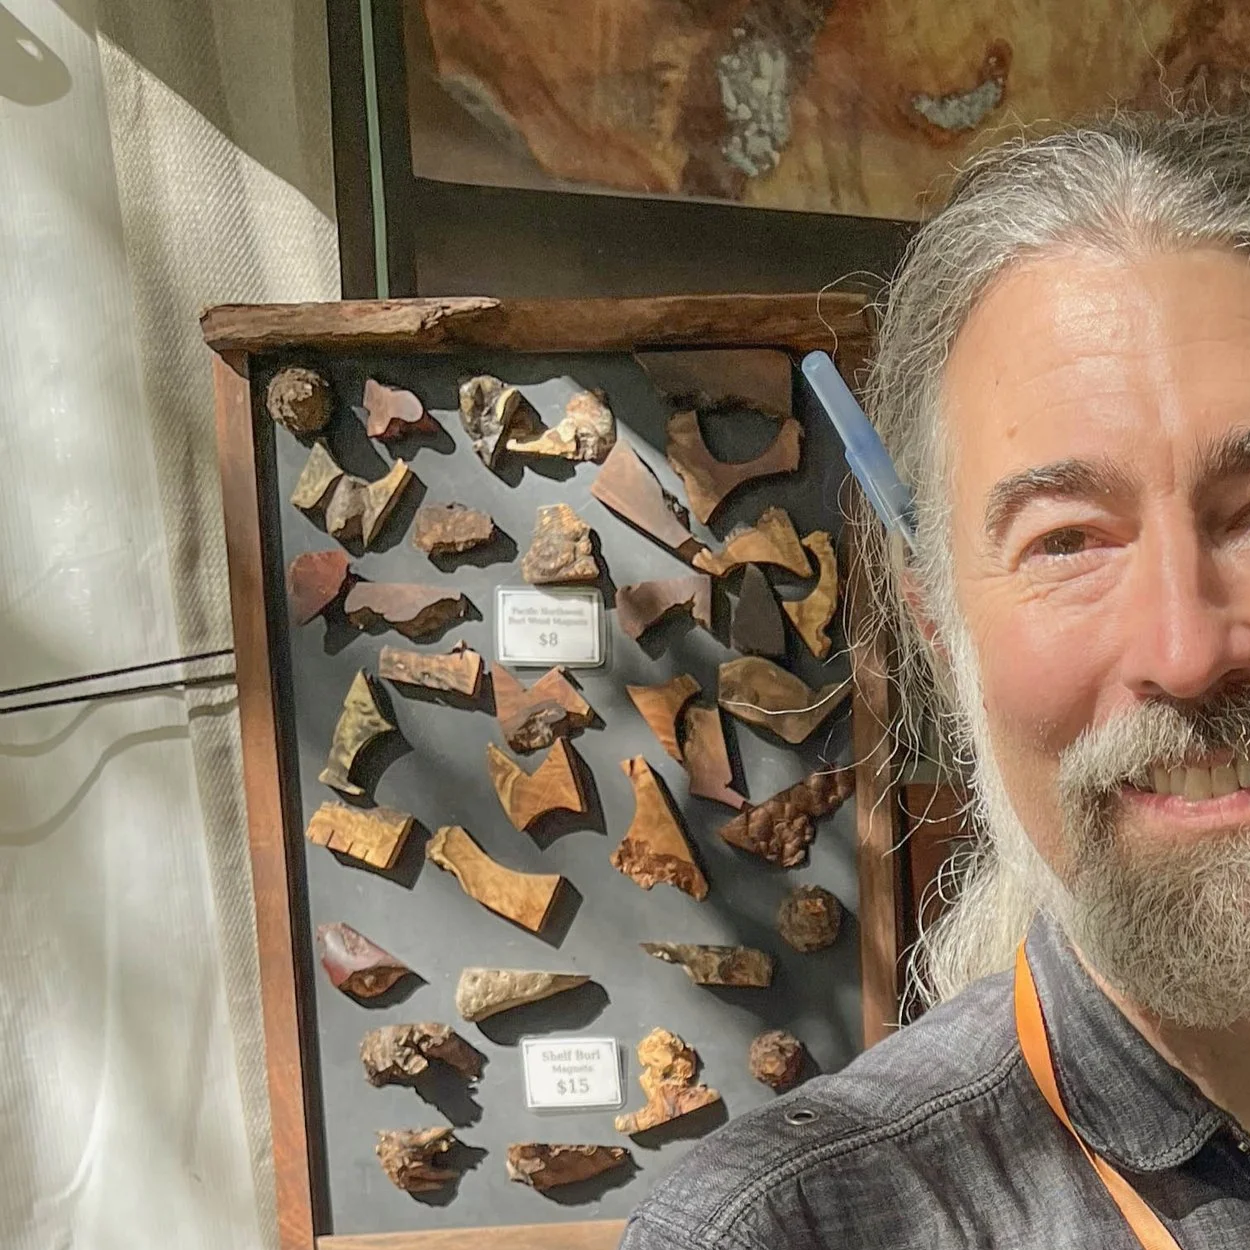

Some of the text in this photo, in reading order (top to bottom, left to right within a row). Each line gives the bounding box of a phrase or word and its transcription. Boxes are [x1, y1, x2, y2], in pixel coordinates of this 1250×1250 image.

[538, 631, 559, 647] $8
[541, 1048, 601, 1062] Shelf Burl
[552, 1064, 594, 1076] Magnets
[556, 1077, 590, 1096] $15
